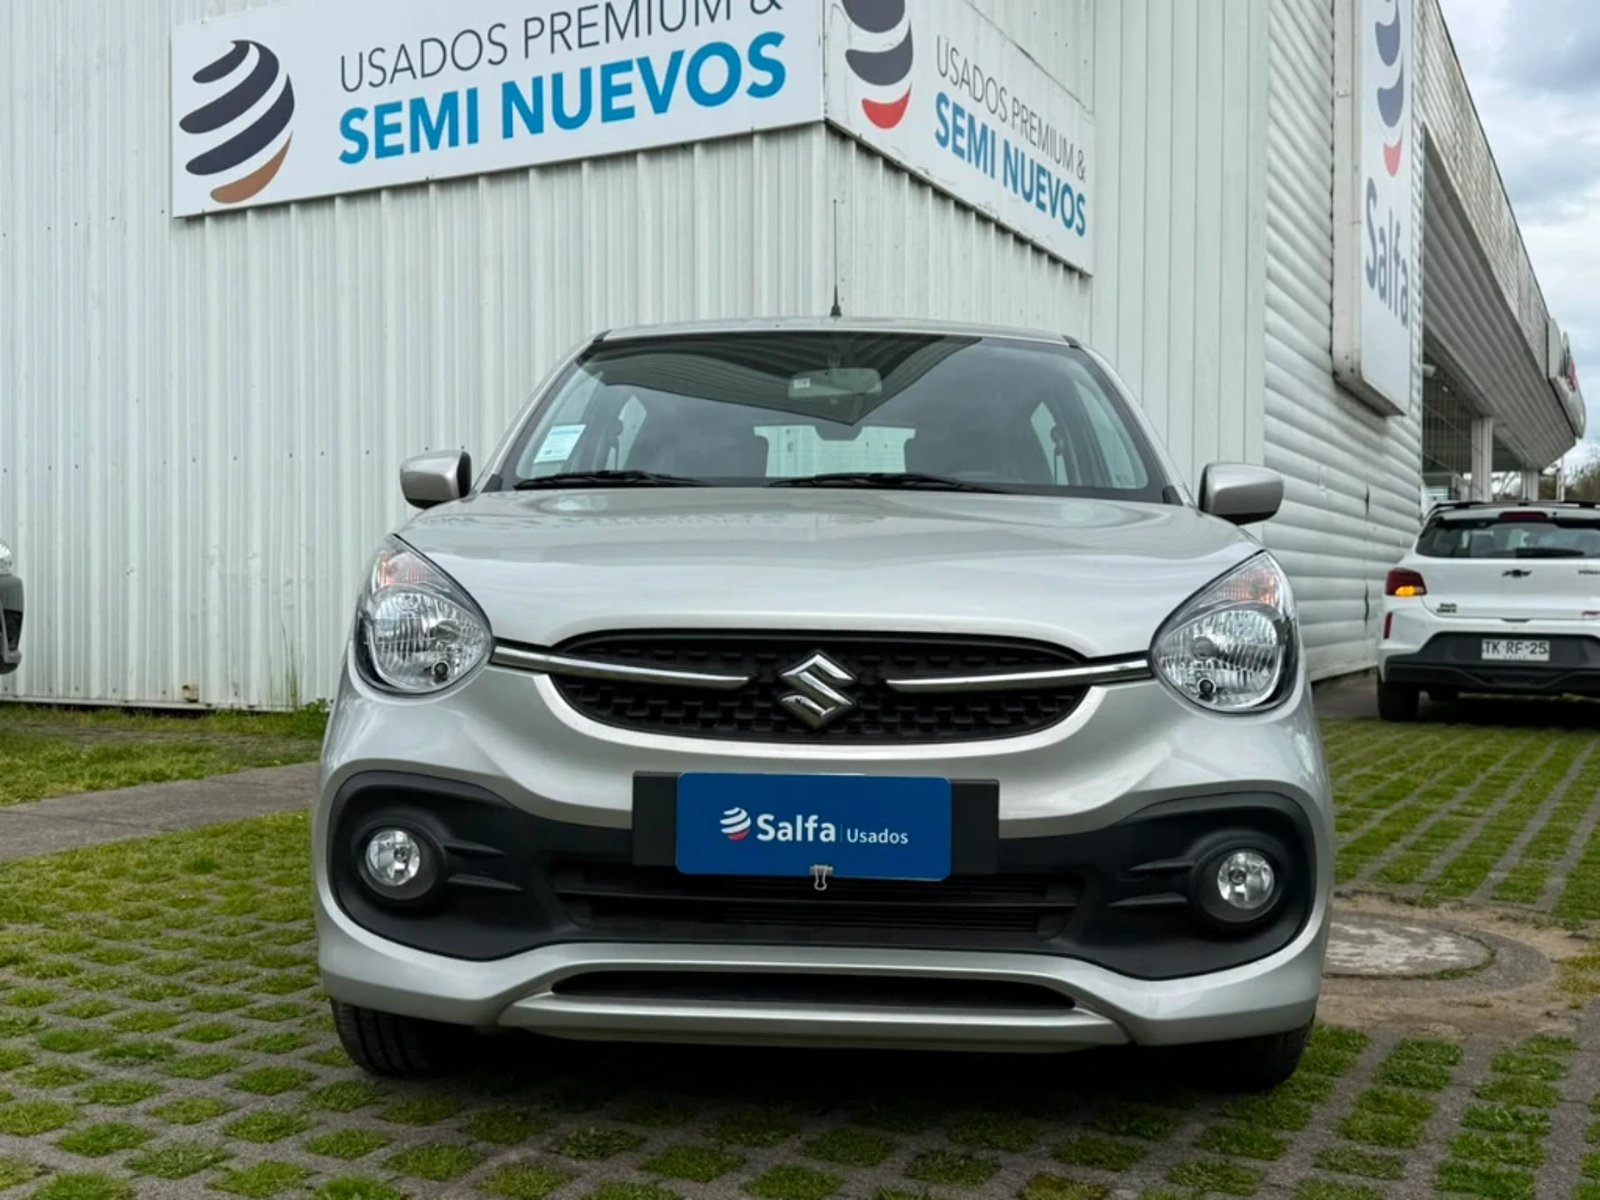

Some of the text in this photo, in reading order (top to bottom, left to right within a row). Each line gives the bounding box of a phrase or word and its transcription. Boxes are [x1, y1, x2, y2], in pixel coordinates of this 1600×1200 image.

[338, 31, 786, 165] SEMI NUEVOS
[341, 22, 508, 93] USADOS
[936, 34, 1008, 123] USADOS
[1011, 96, 1075, 173] PREMIUM
[935, 91, 1087, 237] SEMI NUEVOS
[1365, 177, 1409, 330] Salfa
[756, 813, 909, 846] Salfa Usados
